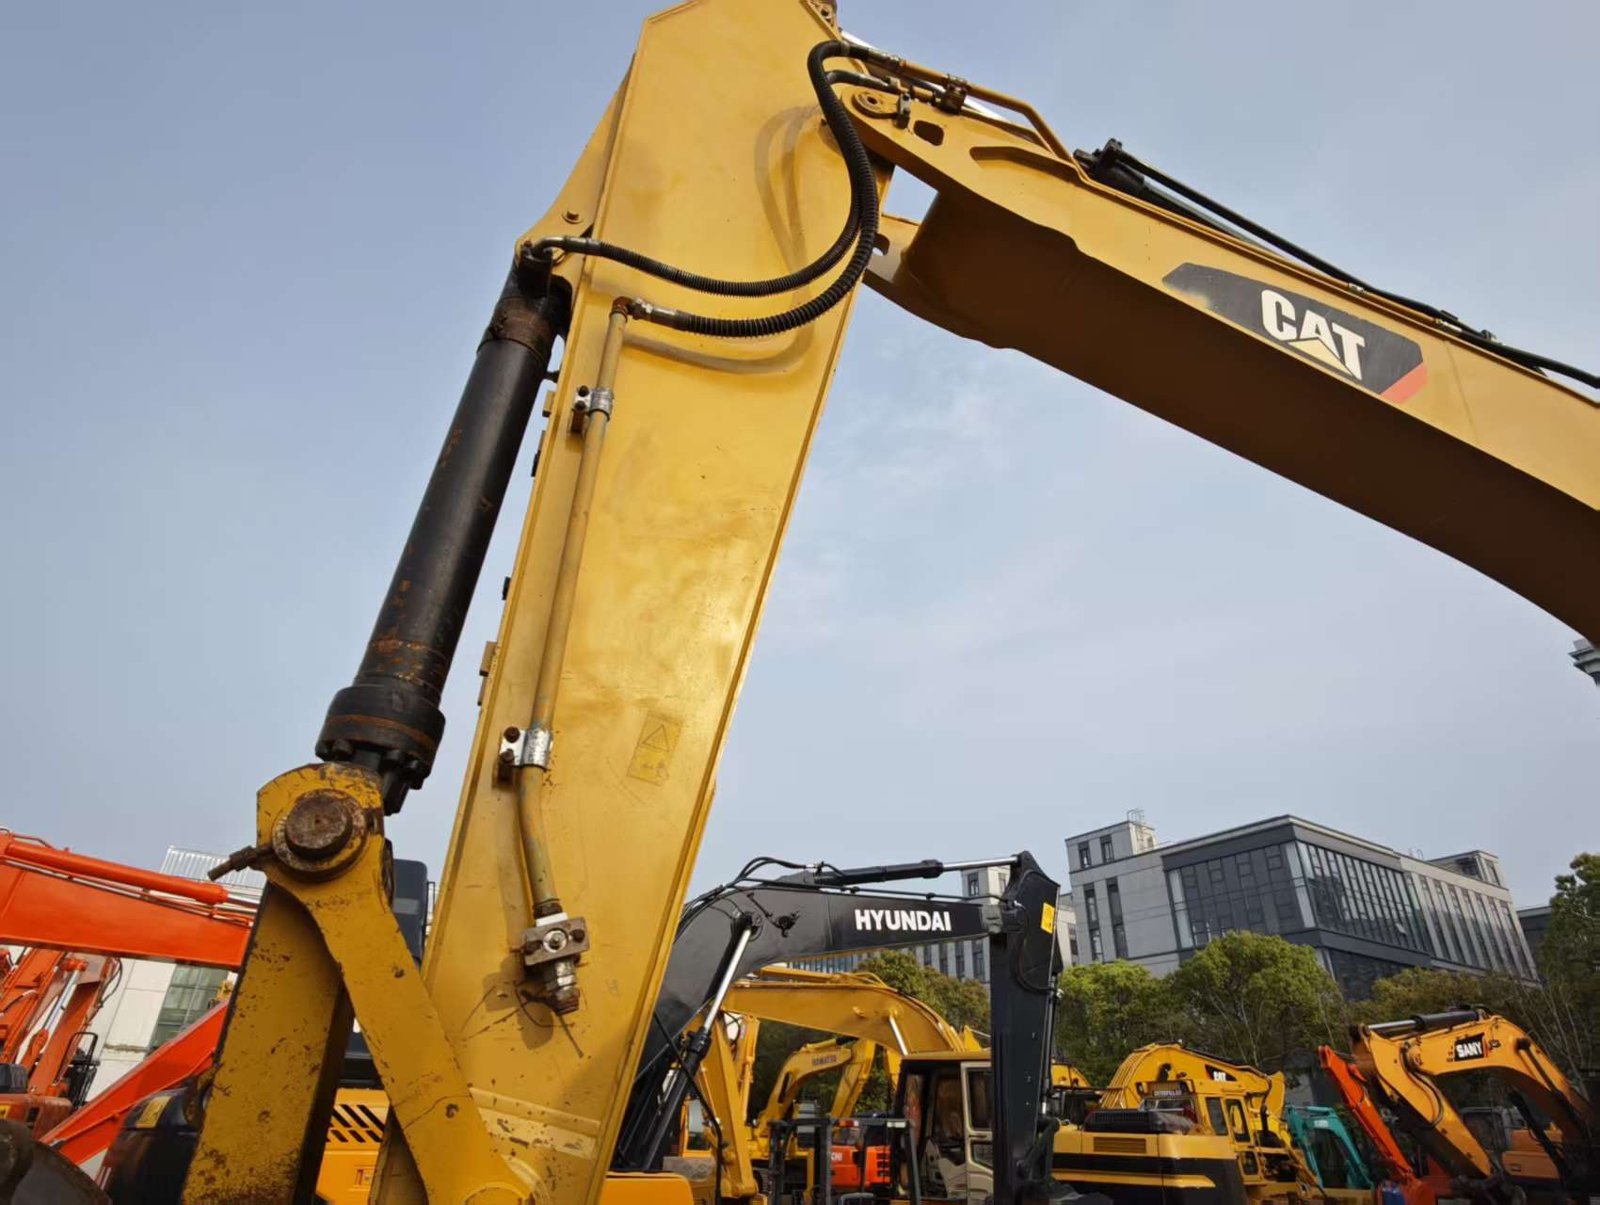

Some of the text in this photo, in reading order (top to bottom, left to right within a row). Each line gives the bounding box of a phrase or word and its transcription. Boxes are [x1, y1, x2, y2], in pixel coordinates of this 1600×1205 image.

[1261, 289, 1365, 380] CAT
[854, 908, 952, 932] HYUNDAI
[1456, 1041, 1482, 1058] SANY
